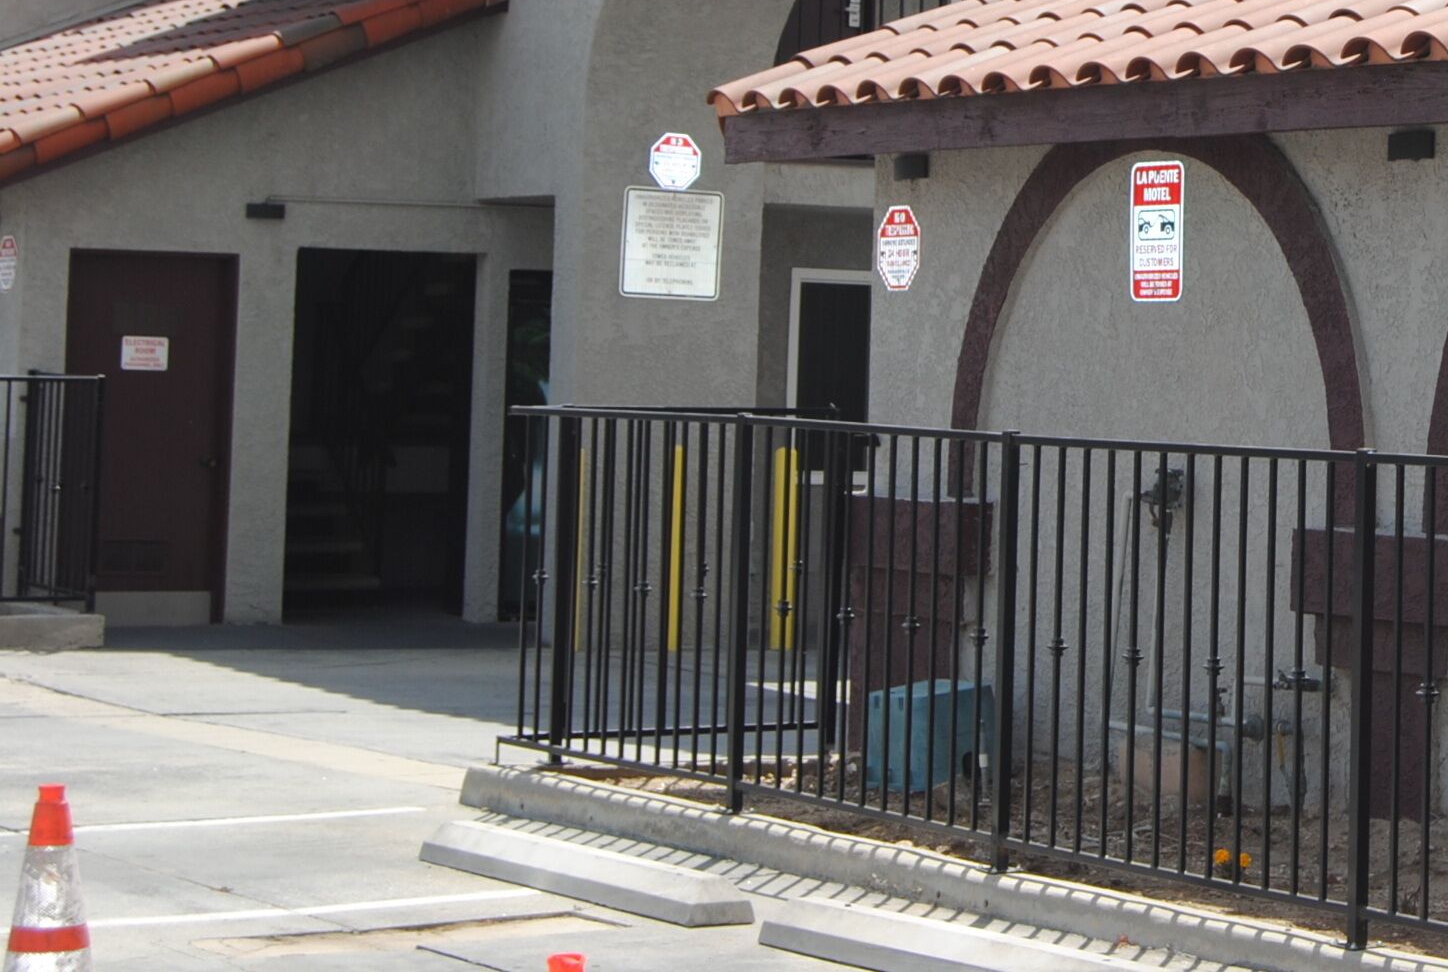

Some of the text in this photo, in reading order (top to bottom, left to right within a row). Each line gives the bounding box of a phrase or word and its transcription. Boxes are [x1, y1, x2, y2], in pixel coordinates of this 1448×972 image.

[1136, 169, 1179, 185] LA PUENTE
[1143, 187, 1172, 202] MOTEL
[1136, 244, 1177, 254] RESERVED FOR
[1139, 257, 1174, 267] CUSTOMERS
